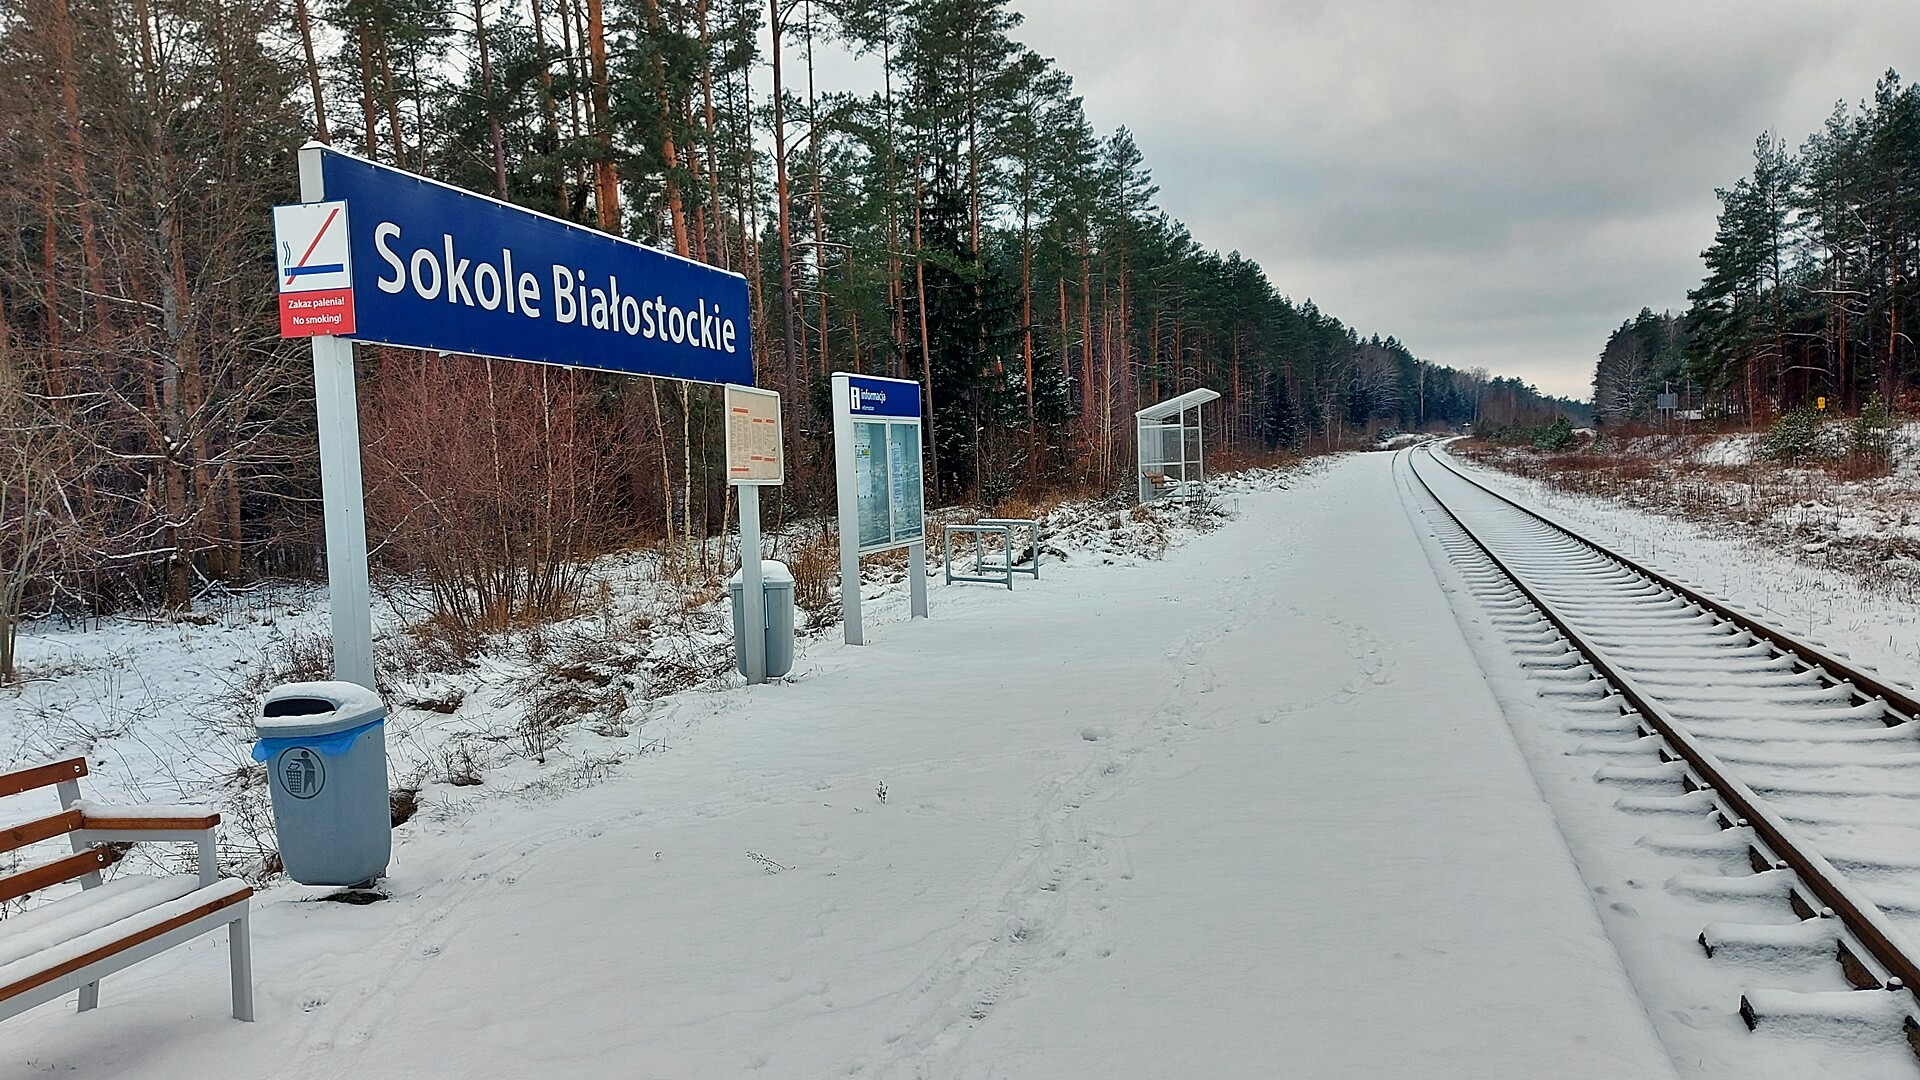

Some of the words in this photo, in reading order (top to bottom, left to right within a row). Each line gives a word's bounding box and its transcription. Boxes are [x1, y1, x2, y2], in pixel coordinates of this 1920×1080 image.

[374, 221, 541, 318] Sokole
[552, 264, 736, 353] Białostockie
[288, 299, 312, 309] Zakaz
[313, 296, 345, 309] palenia!
[292, 316, 305, 325] No
[305, 313, 342, 325] smoking!
